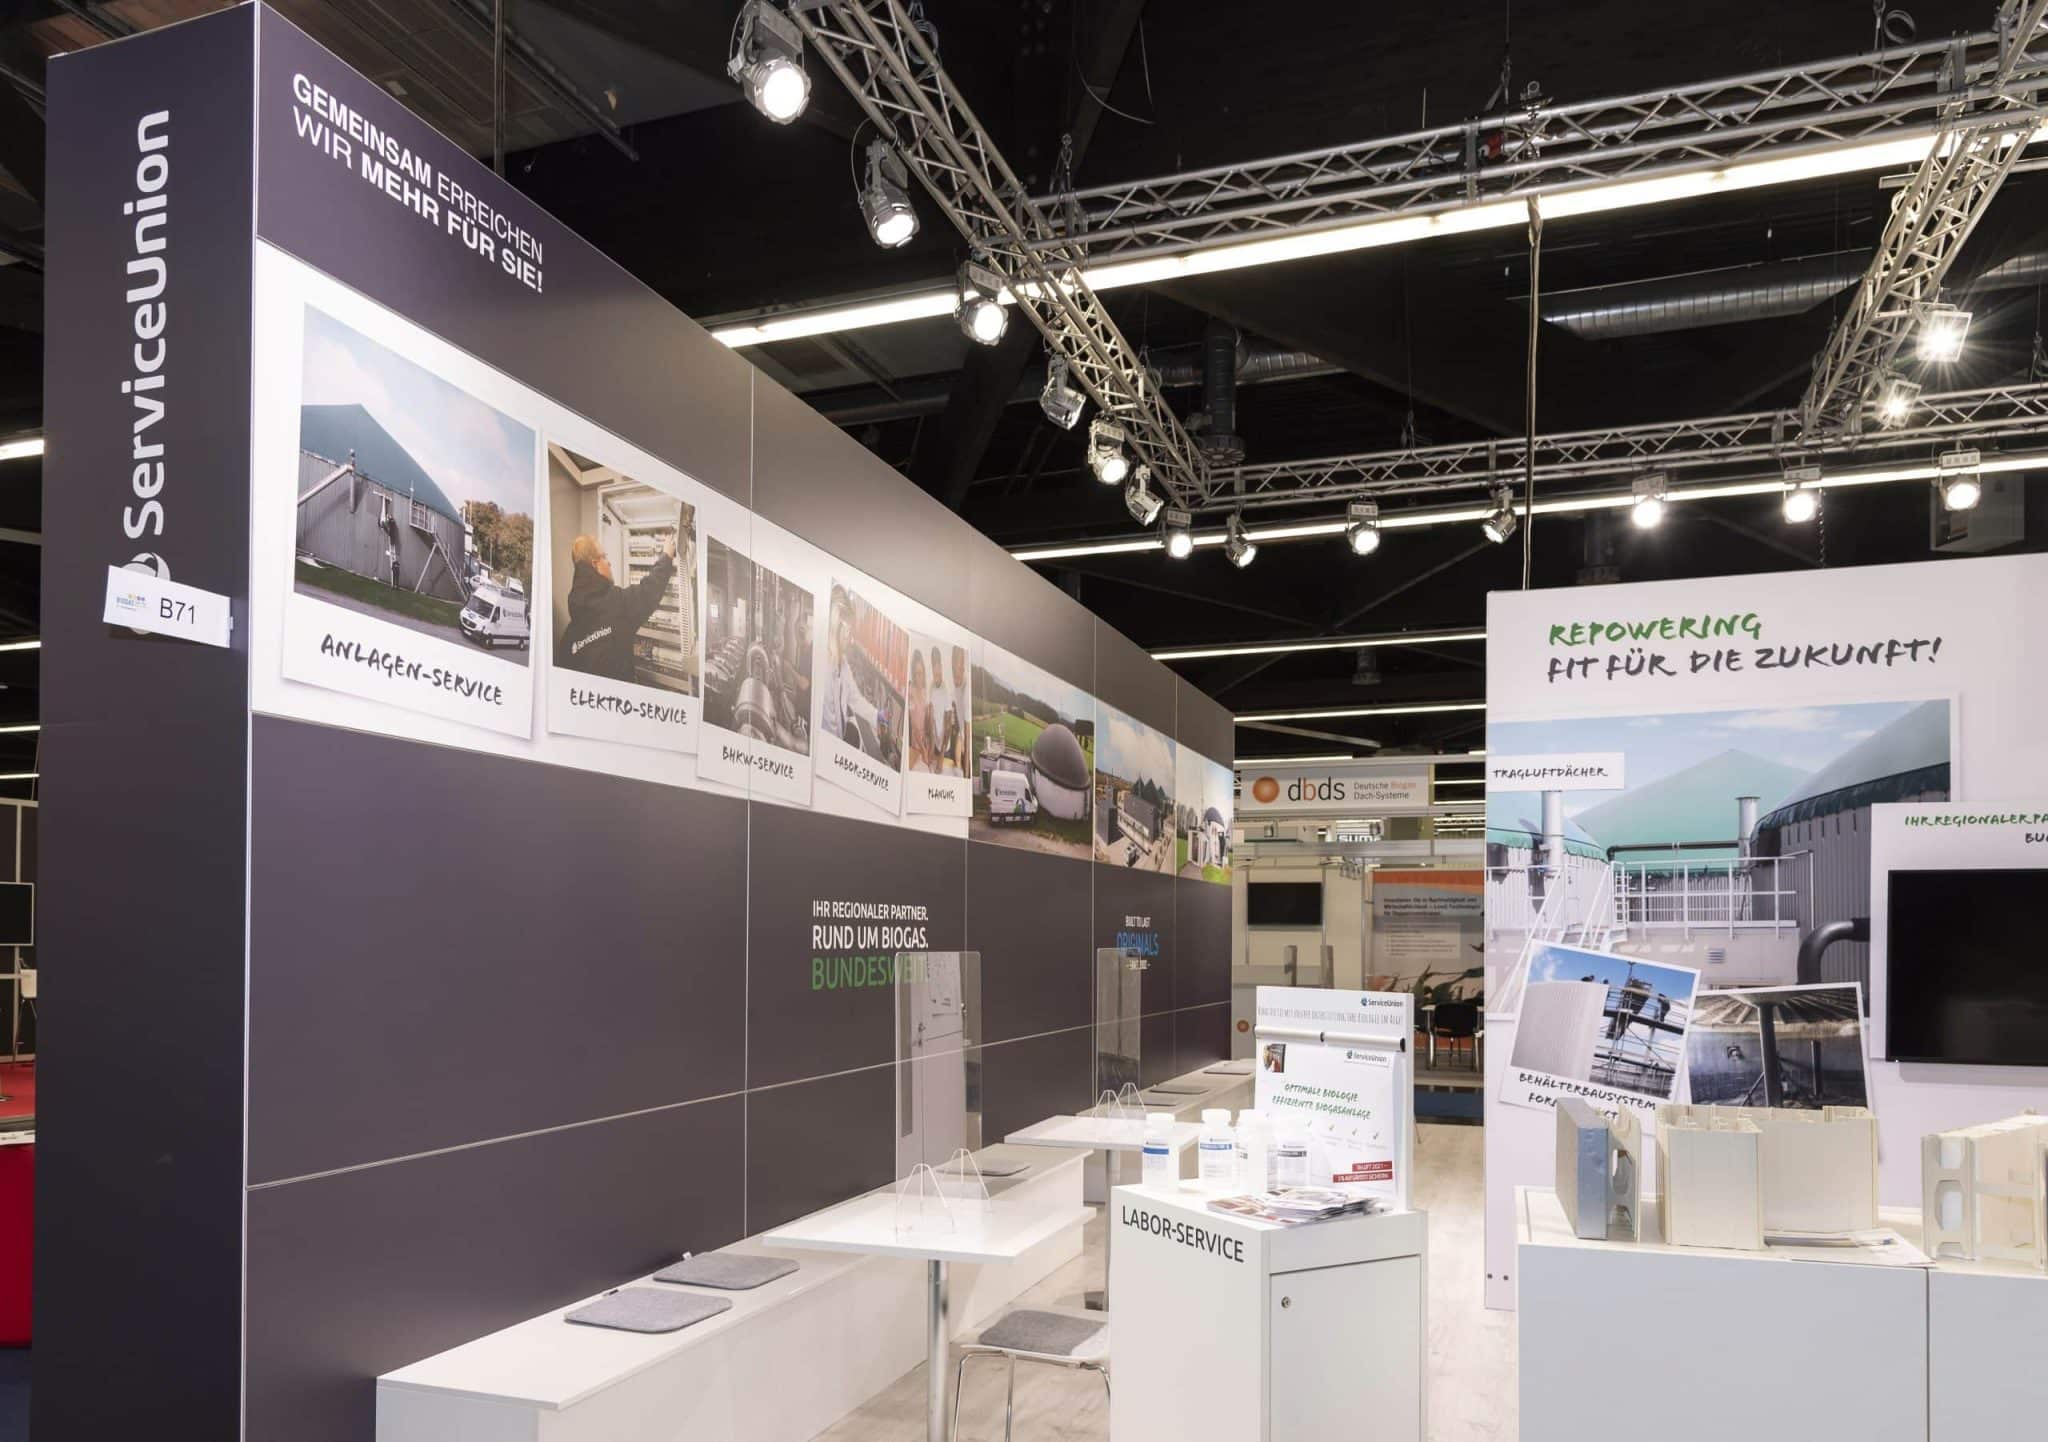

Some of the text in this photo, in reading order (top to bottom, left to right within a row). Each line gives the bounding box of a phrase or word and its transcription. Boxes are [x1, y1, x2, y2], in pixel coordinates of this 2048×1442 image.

[293, 73, 543, 265] GEMEINSAM ERREICHEN
[293, 105, 543, 293] WIR MEHR FÜR SIE!
[121, 110, 169, 538] ServiceUnion
[159, 596, 195, 625] B71
[1549, 613, 1762, 646] REPOWERING
[320, 633, 503, 705] ANLAGEN-SERVICE
[1547, 637, 1943, 683] FIT FÜR DIE ZUKUNFT!
[569, 687, 688, 725] ELEKTRO-SERVICE
[722, 745, 794, 779] BHKW-SERVICE
[833, 753, 889, 791] LABOR-SERVICE
[1493, 763, 1608, 780] TRAGLUFTDÄCHER
[1287, 775, 1345, 801] dbds
[1904, 815, 1932, 826] IHR
[1933, 813, 2032, 827] REGIONALER
[813, 900, 928, 921] IHR REGIONALER PARTNER.
[812, 925, 928, 949] RUND UM BIOGAS.
[1368, 999, 1403, 1007] ServiceUnion
[1284, 1083, 1359, 1103] OPTIMALE BIOLOGIE
[1519, 1072, 1656, 1110] BEHÄLTERBAUSYSTEM
[1122, 1205, 1244, 1263] LABOR-SERVICE
